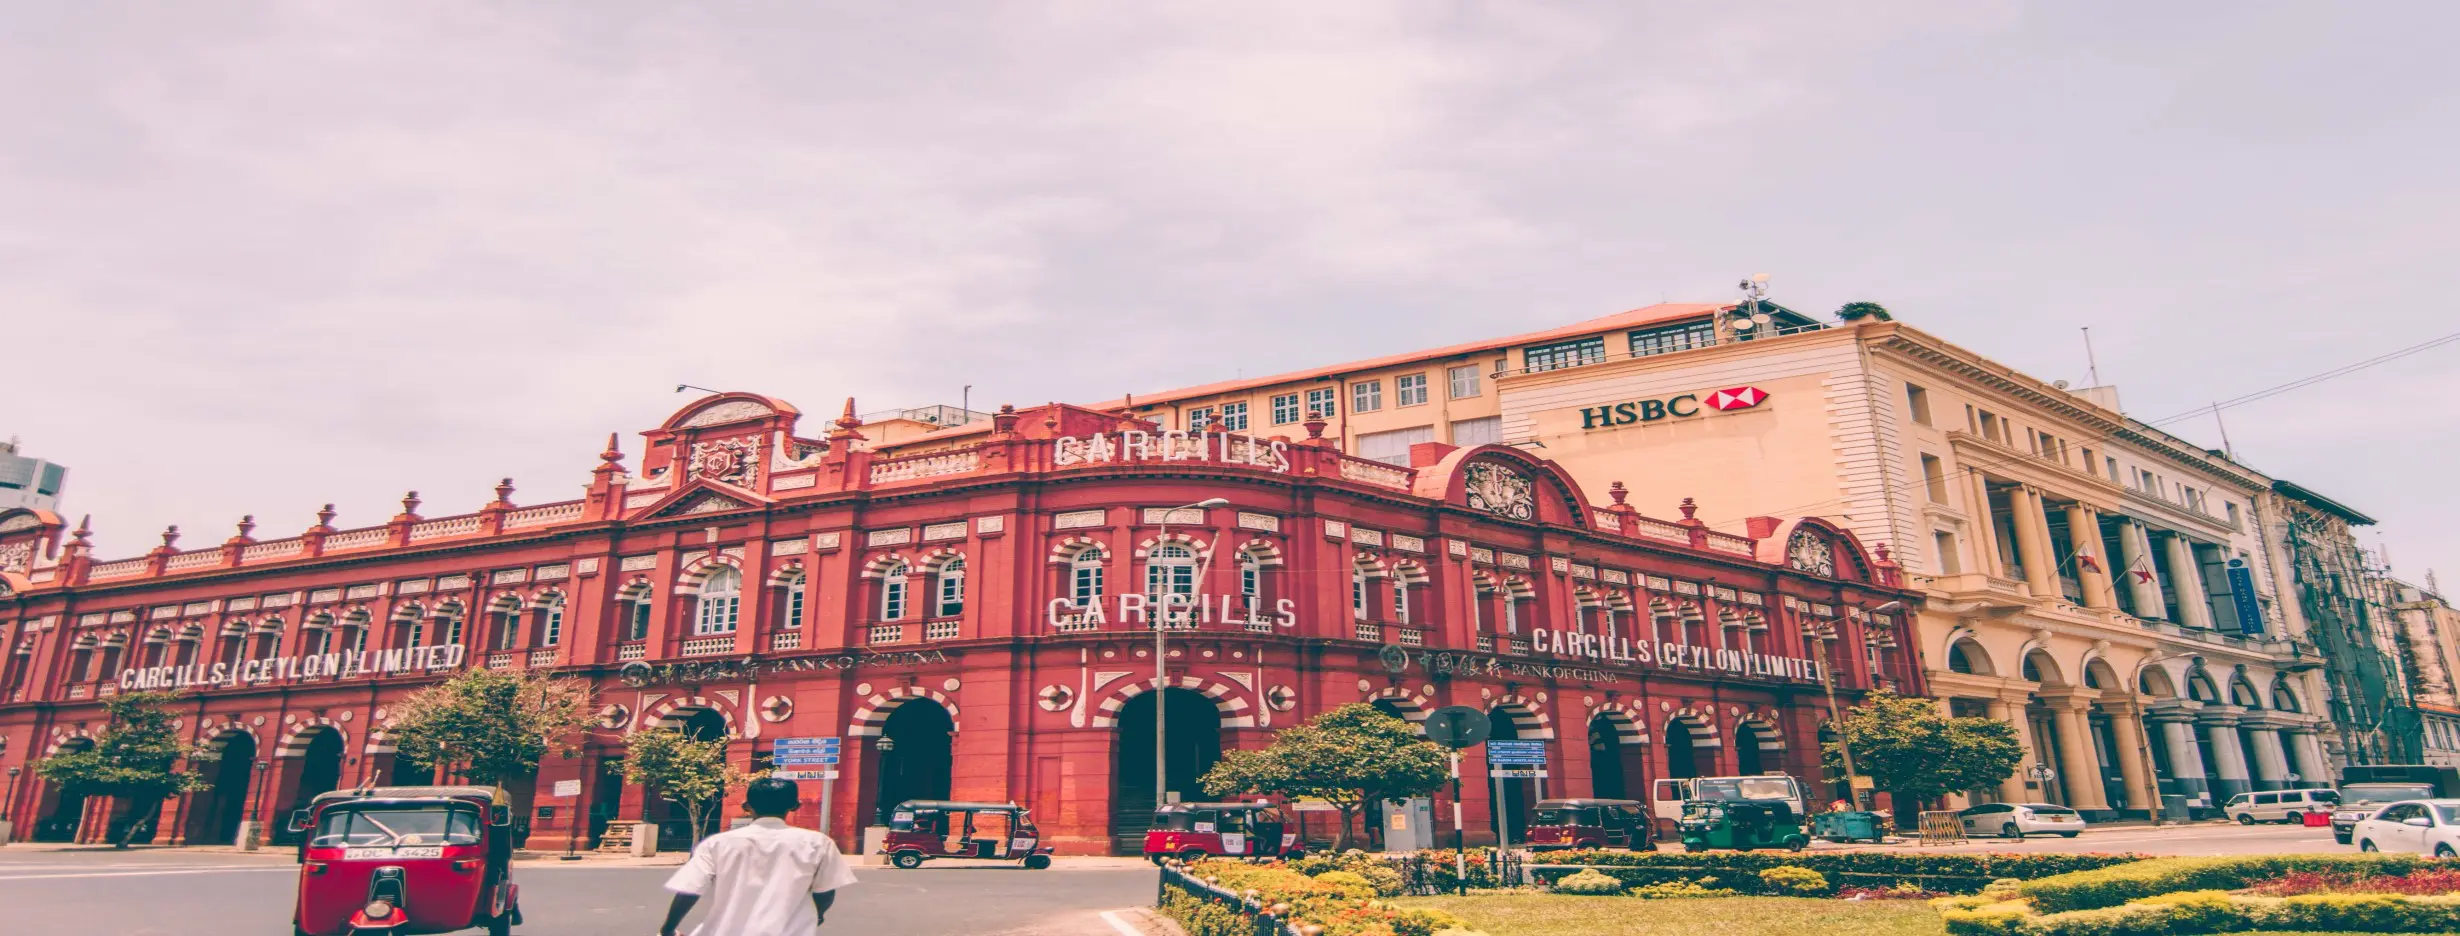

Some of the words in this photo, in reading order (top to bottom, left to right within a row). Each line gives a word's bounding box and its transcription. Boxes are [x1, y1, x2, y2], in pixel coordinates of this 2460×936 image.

[1579, 394, 1700, 429] HSBC
[1053, 429, 1290, 474] CARGILLS
[1049, 593, 1296, 627] CARGILLS
[1532, 627, 1651, 663] CARGILLS
[120, 661, 226, 690] CARGILLS
[231, 648, 352, 687] (CEYLON)
[357, 643, 466, 674] LIMITED
[1511, 663, 1552, 679] BANK
